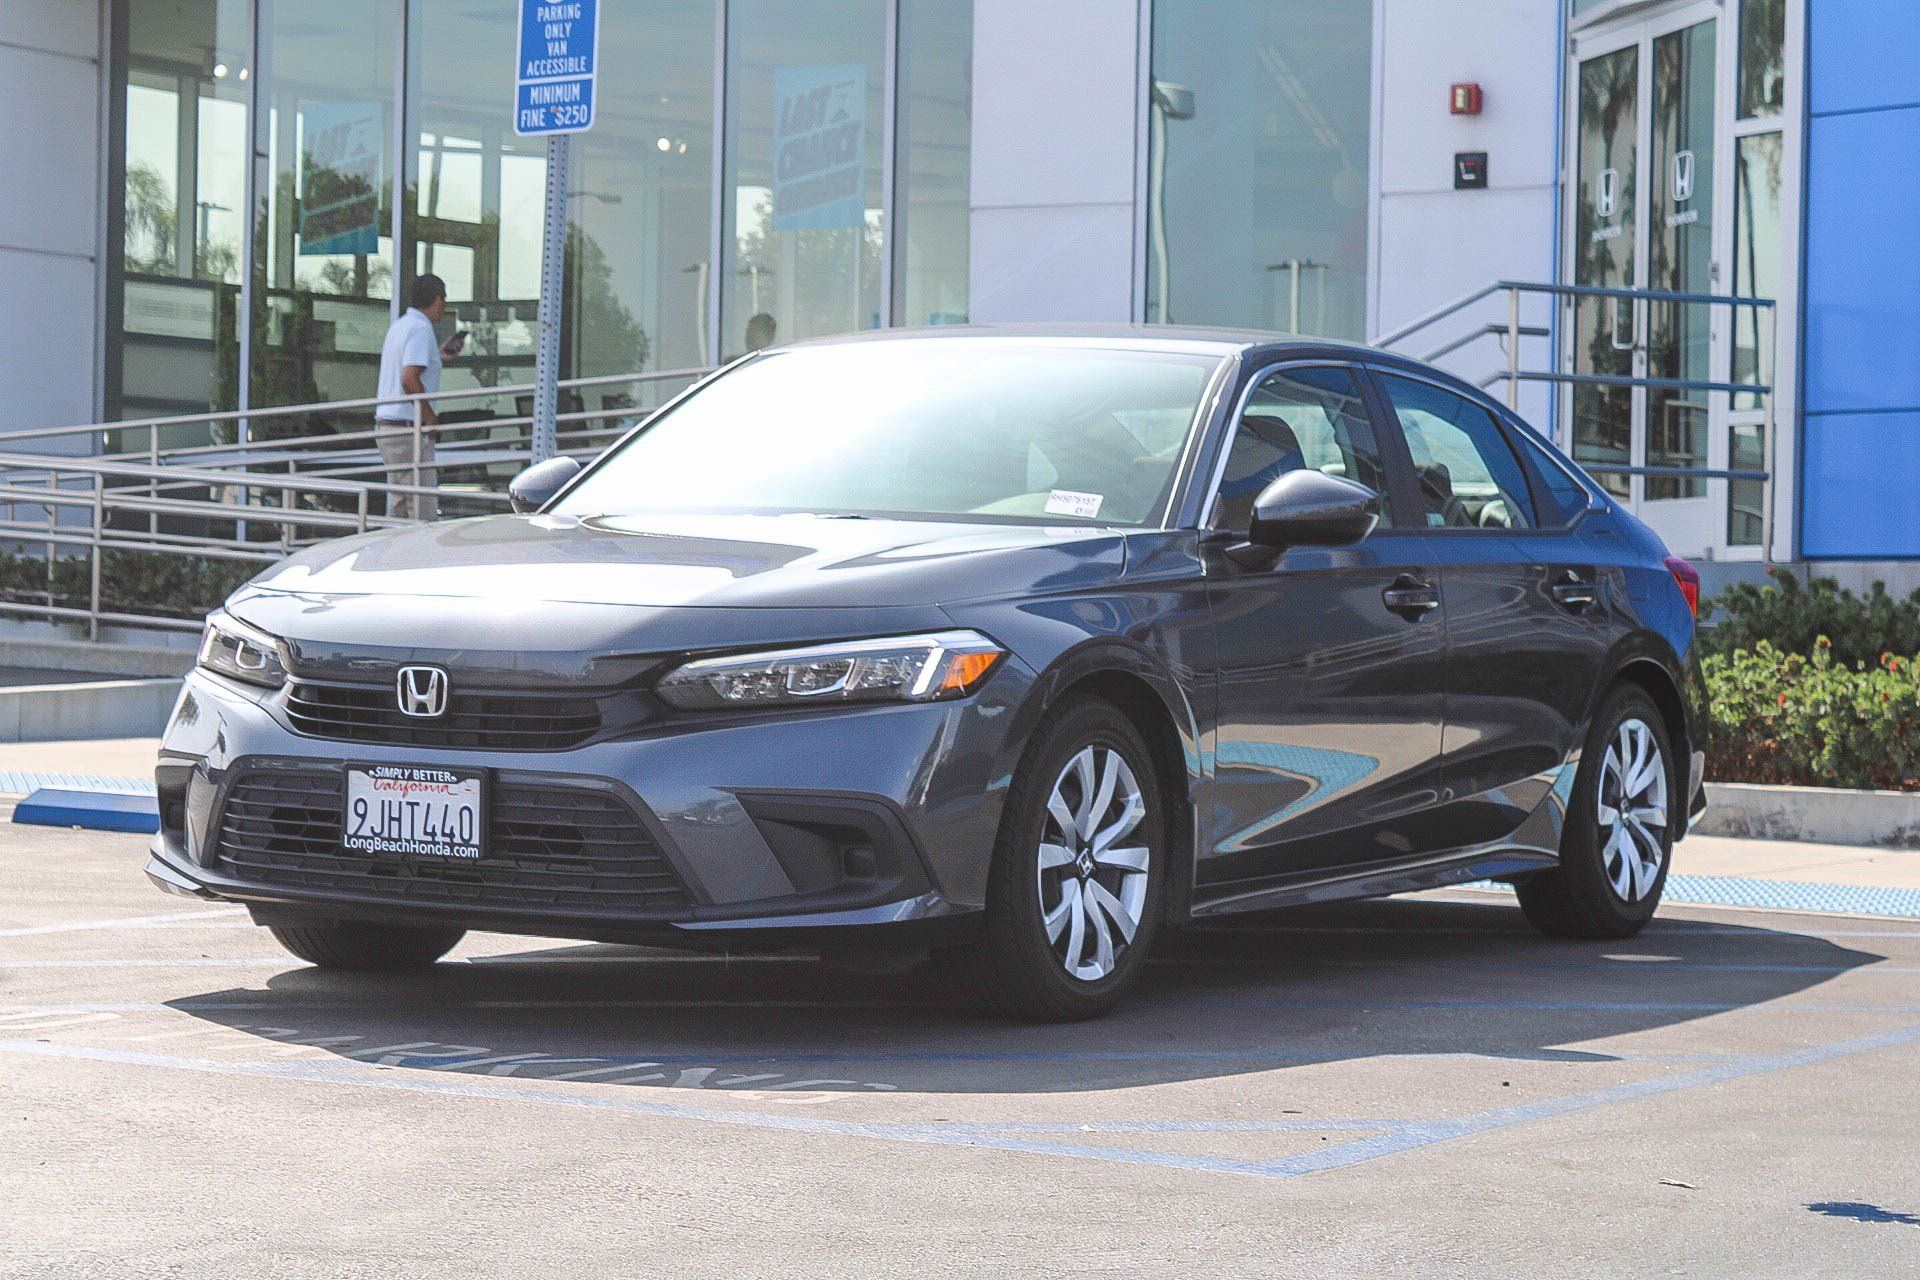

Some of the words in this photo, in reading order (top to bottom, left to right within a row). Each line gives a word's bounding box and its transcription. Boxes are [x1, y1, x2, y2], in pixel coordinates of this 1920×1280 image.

[537, 3, 581, 22] PARKING
[544, 22, 572, 39] ONLY
[547, 40, 568, 56] VAN
[526, 56, 587, 76] ACCESSIBLE
[530, 83, 580, 105] MINIMUM
[521, 108, 546, 128] FINE
[374, 766, 411, 780] SIMPLY
[413, 769, 452, 782] BETTER
[373, 778, 459, 798] California
[353, 797, 473, 845] 9JHT440
[344, 835, 479, 858] LongBeachHonda.com
